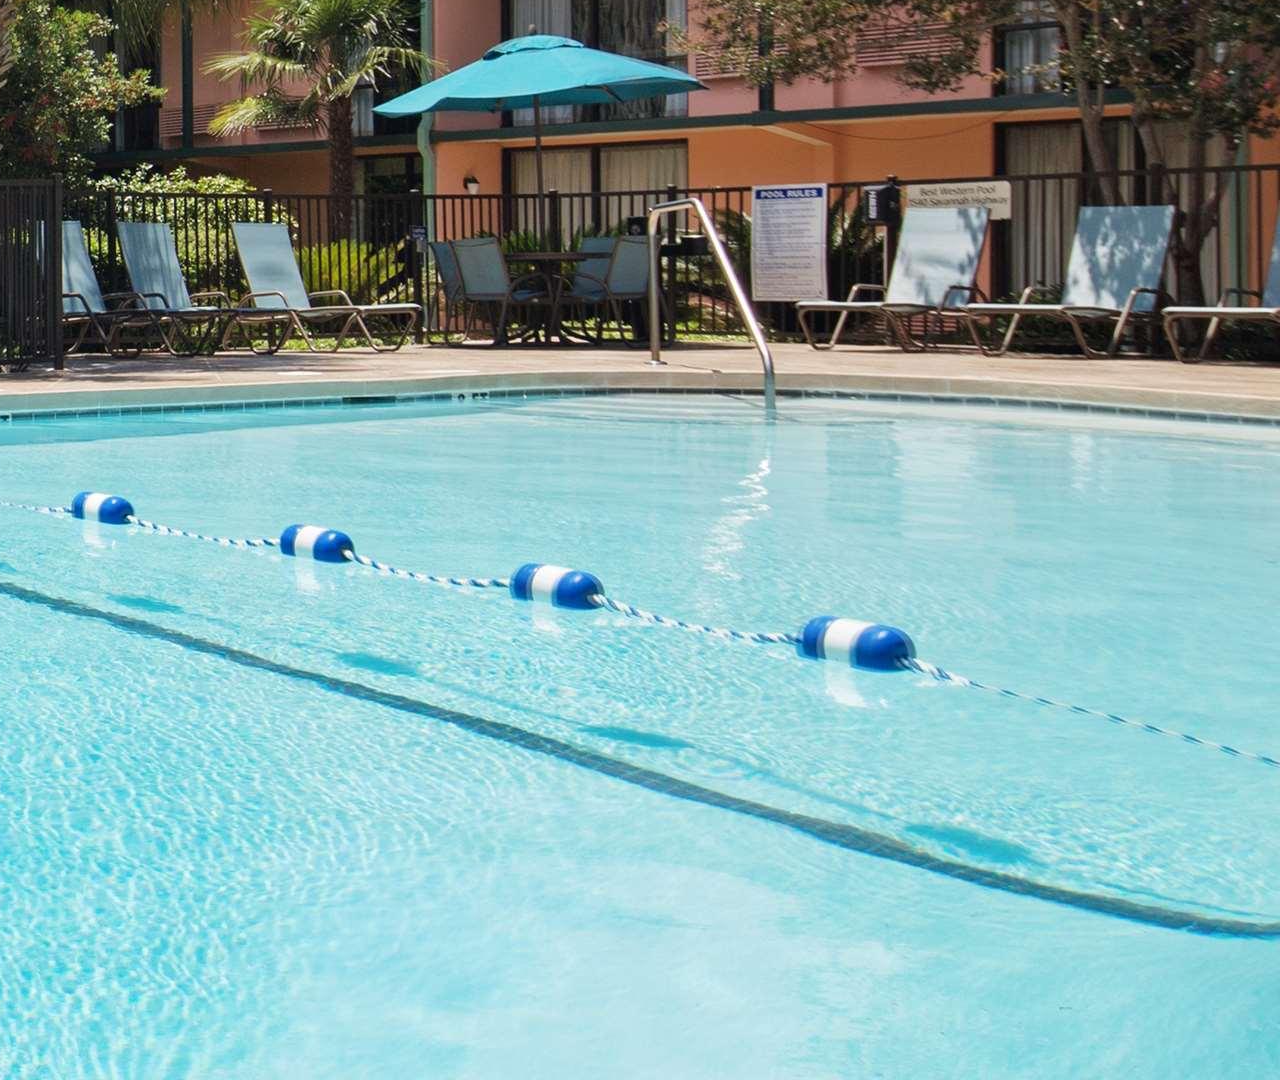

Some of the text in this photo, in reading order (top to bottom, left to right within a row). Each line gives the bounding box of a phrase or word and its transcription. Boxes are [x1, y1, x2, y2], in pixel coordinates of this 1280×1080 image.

[760, 189, 818, 199] POOL RULES
[940, 185, 975, 195] Western
[976, 184, 996, 194] Pool
